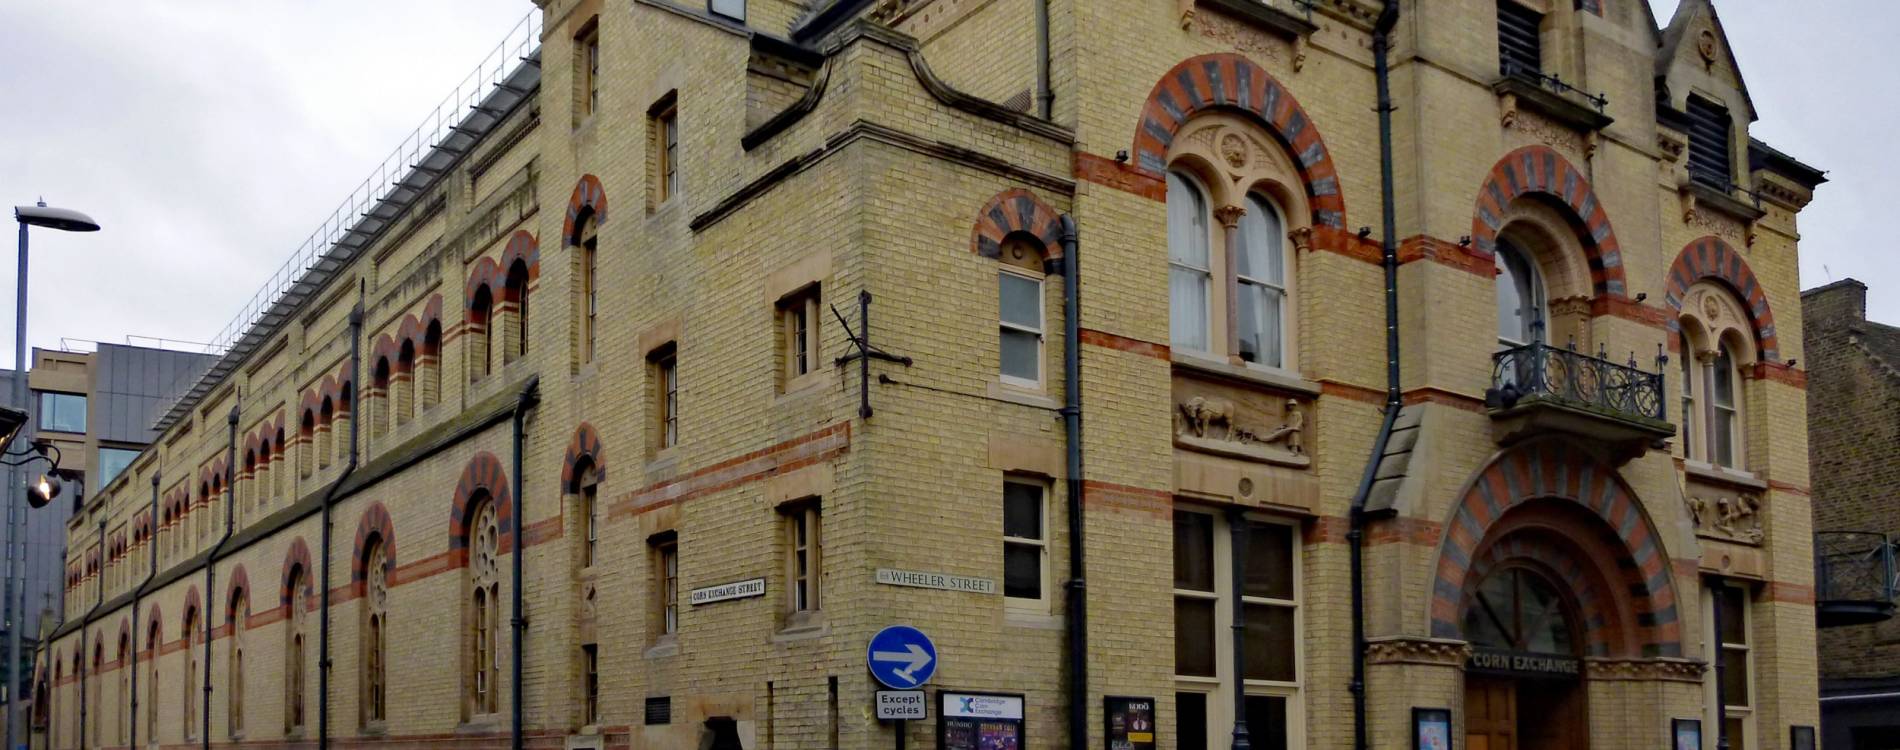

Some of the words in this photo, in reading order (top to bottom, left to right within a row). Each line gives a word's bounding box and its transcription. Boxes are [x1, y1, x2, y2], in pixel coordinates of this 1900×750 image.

[891, 571, 945, 587] WHEELER
[950, 577, 992, 592] STREET
[693, 591, 707, 601] CORN
[708, 586, 737, 599] EXCHANGE
[738, 582, 762, 594] STREET
[1473, 653, 1509, 669] CORN
[1513, 656, 1579, 674] EXCHANGE
[881, 694, 921, 705] Except
[883, 705, 919, 716] cycles
